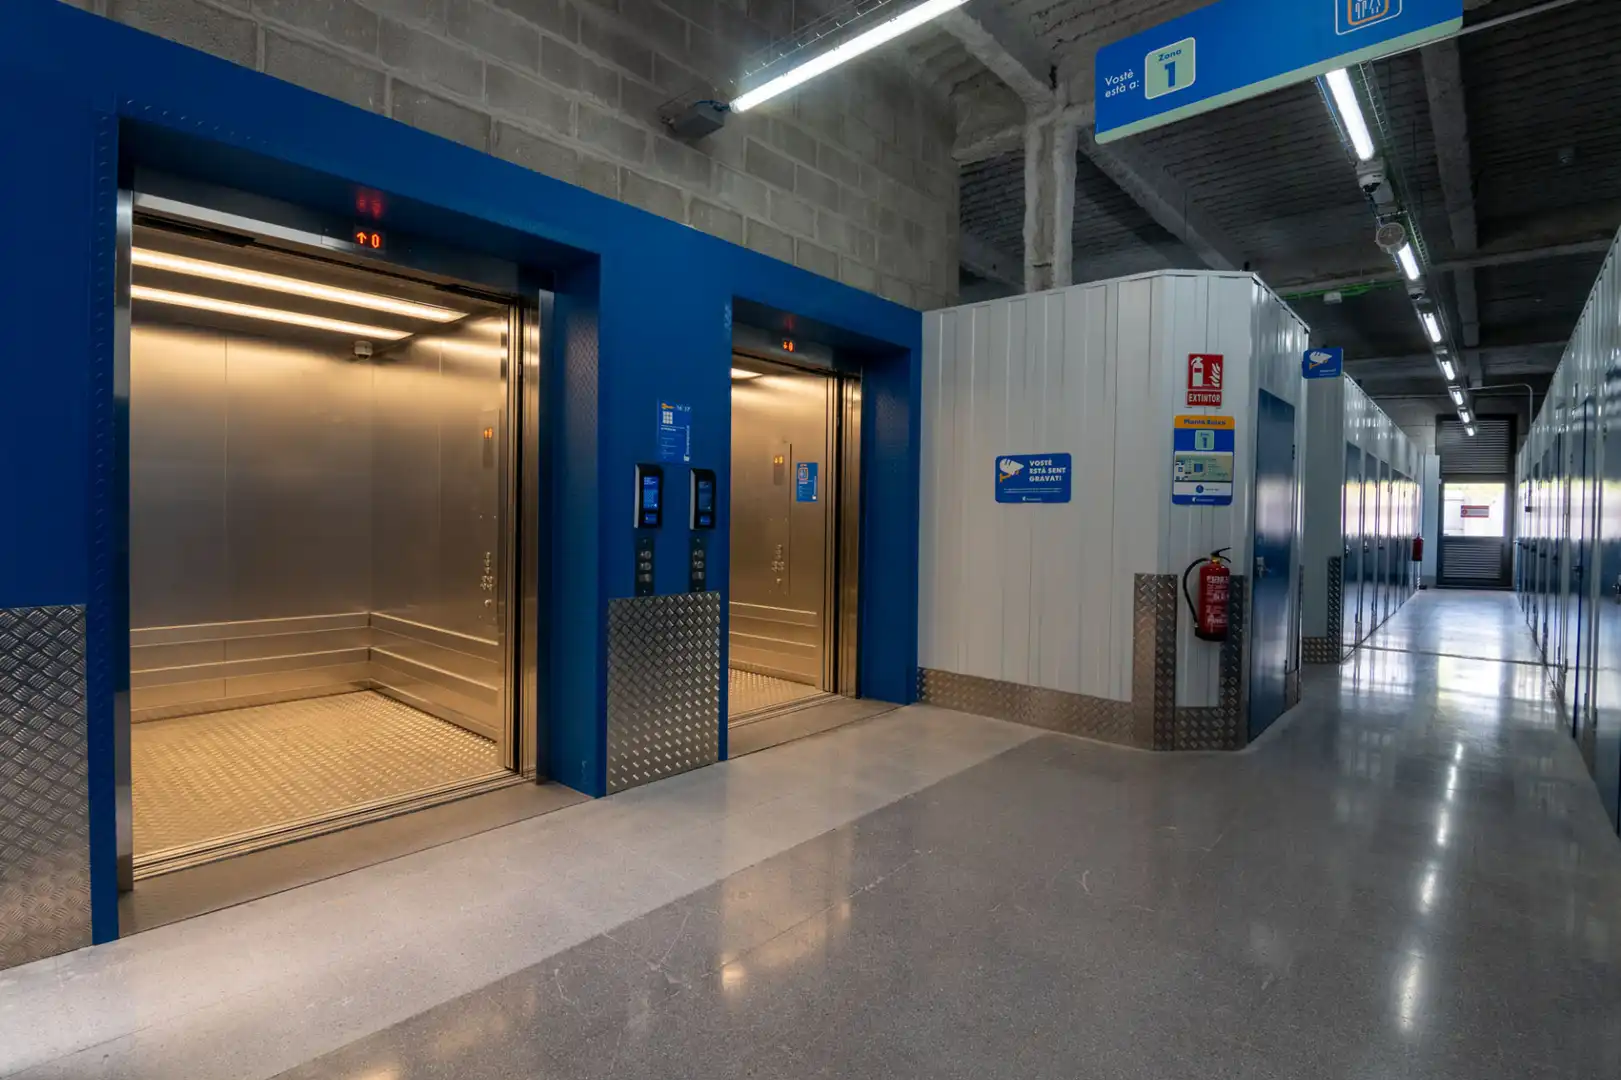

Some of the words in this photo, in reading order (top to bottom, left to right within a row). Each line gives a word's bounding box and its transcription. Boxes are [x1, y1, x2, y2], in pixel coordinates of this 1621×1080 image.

[1158, 49, 1182, 62] Zona
[1105, 69, 1133, 86] Vostè
[1164, 61, 1176, 88] 1
[1105, 81, 1127, 98] està
[1129, 80, 1140, 90] a:
[371, 233, 381, 249] 0
[1188, 393, 1221, 403] EXTINTOR
[1202, 437, 1208, 448] 1
